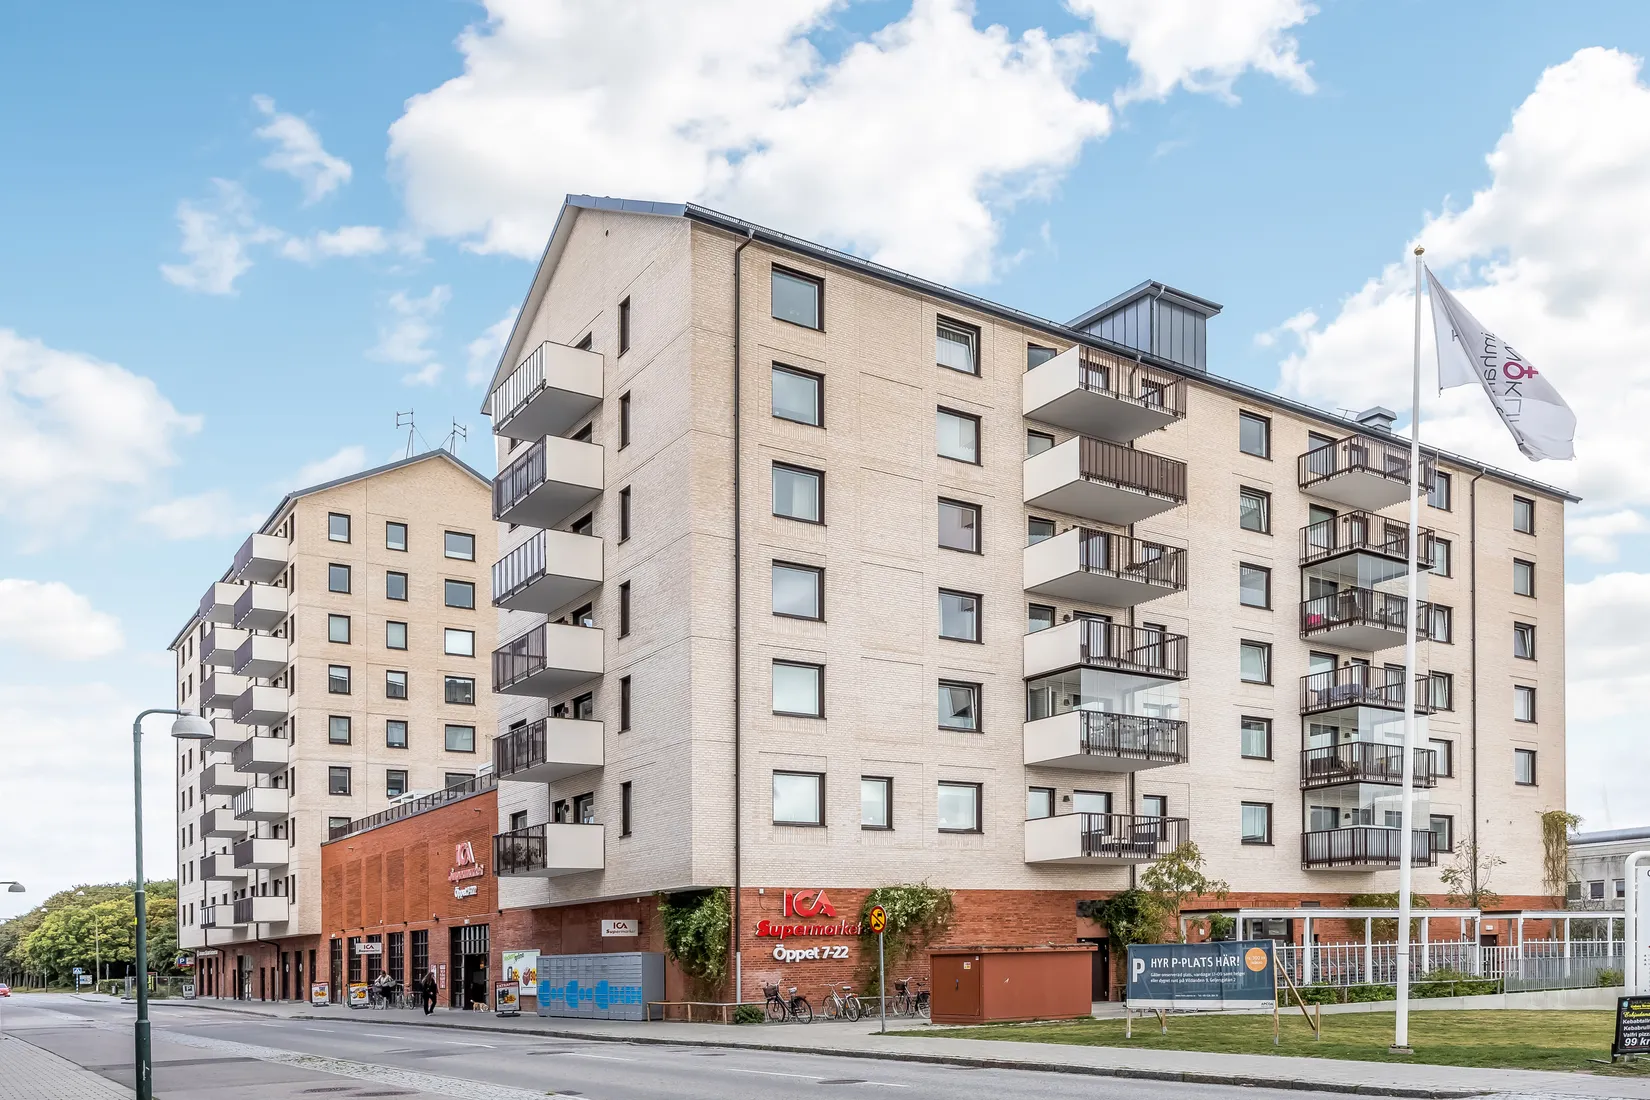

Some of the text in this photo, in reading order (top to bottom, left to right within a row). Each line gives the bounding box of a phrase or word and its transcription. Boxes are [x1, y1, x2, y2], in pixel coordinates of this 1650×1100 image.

[784, 889, 837, 918] ICA
[613, 922, 628, 930] ICA
[755, 920, 862, 940] Supermarket
[772, 944, 850, 962] Öppet 7-22
[1150, 954, 1240, 968] HYR P-PLATS HÄR!
[1132, 958, 1145, 983] P
[1624, 1038, 1638, 1046] 99
